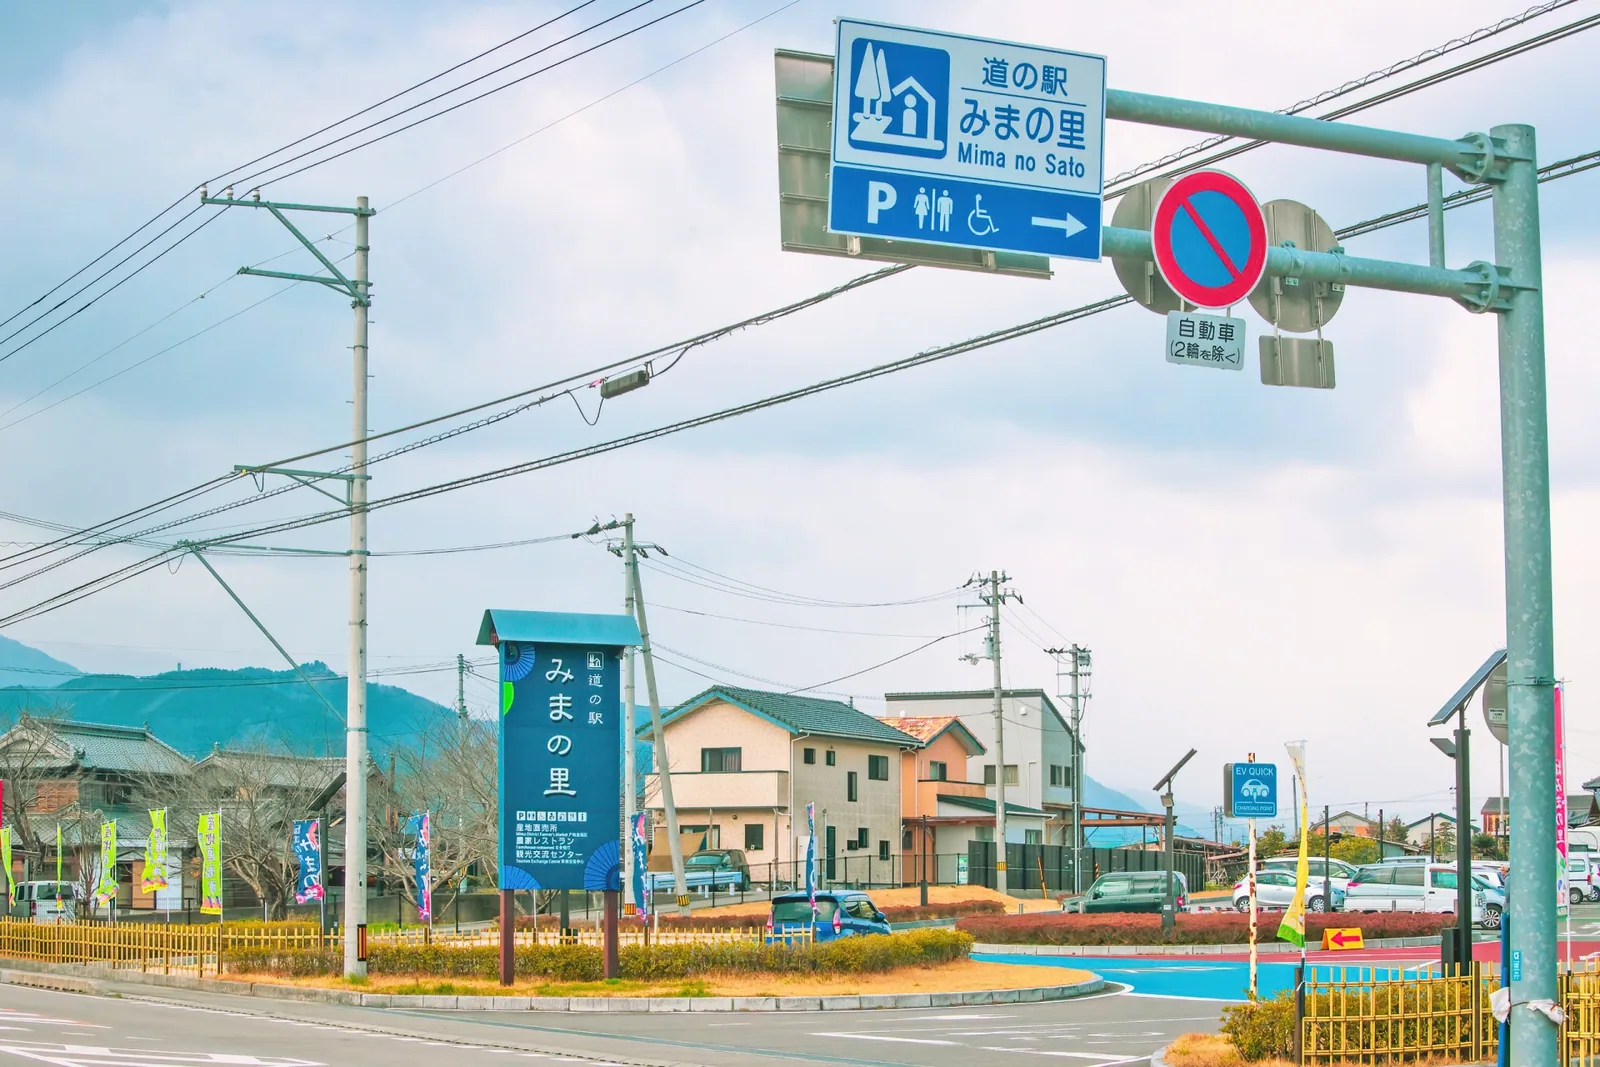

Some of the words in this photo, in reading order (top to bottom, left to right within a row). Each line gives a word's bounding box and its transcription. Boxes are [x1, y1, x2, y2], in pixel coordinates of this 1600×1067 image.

[982, 56, 1068, 96] 道の駅
[959, 98, 1086, 150] みまの里
[957, 141, 1006, 168] Mima
[1014, 154, 1036, 172] no
[1045, 153, 1086, 178] Sato
[866, 180, 898, 225] P
[1179, 318, 1235, 342] 自動車
[1170, 340, 1240, 364] (2輪を除く)
[587, 673, 604, 724] 道の駅
[543, 658, 577, 796] みまの里
[1236, 767, 1247, 775] EV
[1248, 767, 1274, 776] QUICK
[516, 823, 557, 832] 産地直売所
[516, 837, 575, 845] 農家レストラン
[516, 850, 583, 859] 観光交流センター
